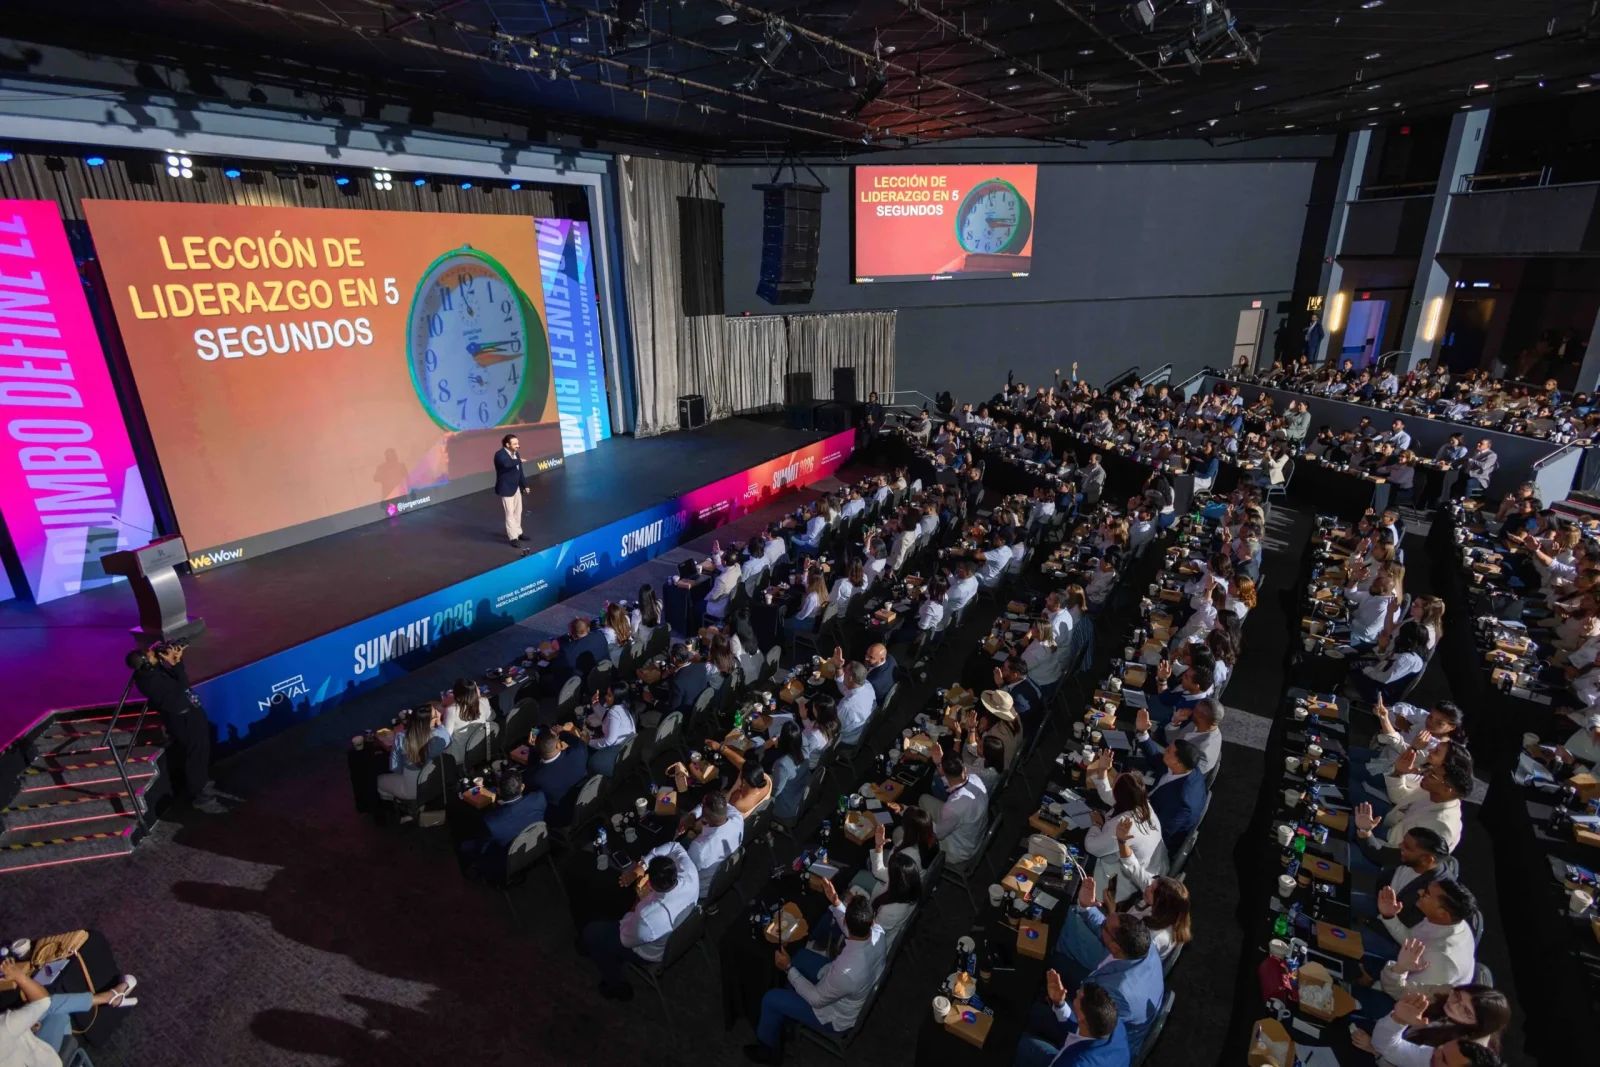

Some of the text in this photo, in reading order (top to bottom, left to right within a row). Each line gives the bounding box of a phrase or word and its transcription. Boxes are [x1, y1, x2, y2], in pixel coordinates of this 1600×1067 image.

[874, 174, 947, 188] LECCIÓN DE
[861, 190, 959, 203] LIDERAZGO EN 5
[876, 204, 944, 217] SEGUNDOS
[159, 230, 364, 270] LECCIÓN DE
[458, 272, 475, 297] 12
[487, 281, 494, 303] 1
[128, 277, 400, 320] LIDERAZGO EN 5
[440, 286, 453, 311] 11
[501, 300, 512, 322] 2
[427, 313, 443, 337] 10
[194, 317, 374, 361] SEGUNDOS
[511, 331, 521, 352] 3
[425, 350, 437, 372] 9
[508, 364, 519, 385] 4
[438, 379, 451, 403] 8
[497, 386, 508, 409] 5
[456, 398, 467, 420] 7
[478, 402, 489, 424] 6
[772, 462, 799, 490] SUMMIT
[621, 510, 687, 557] SUMMIT 2026
[189, 547, 243, 569] WeWow!
[572, 558, 599, 576] NOVAL
[354, 599, 474, 675] SUMMIT 2026
[258, 682, 310, 712] NOVAL
